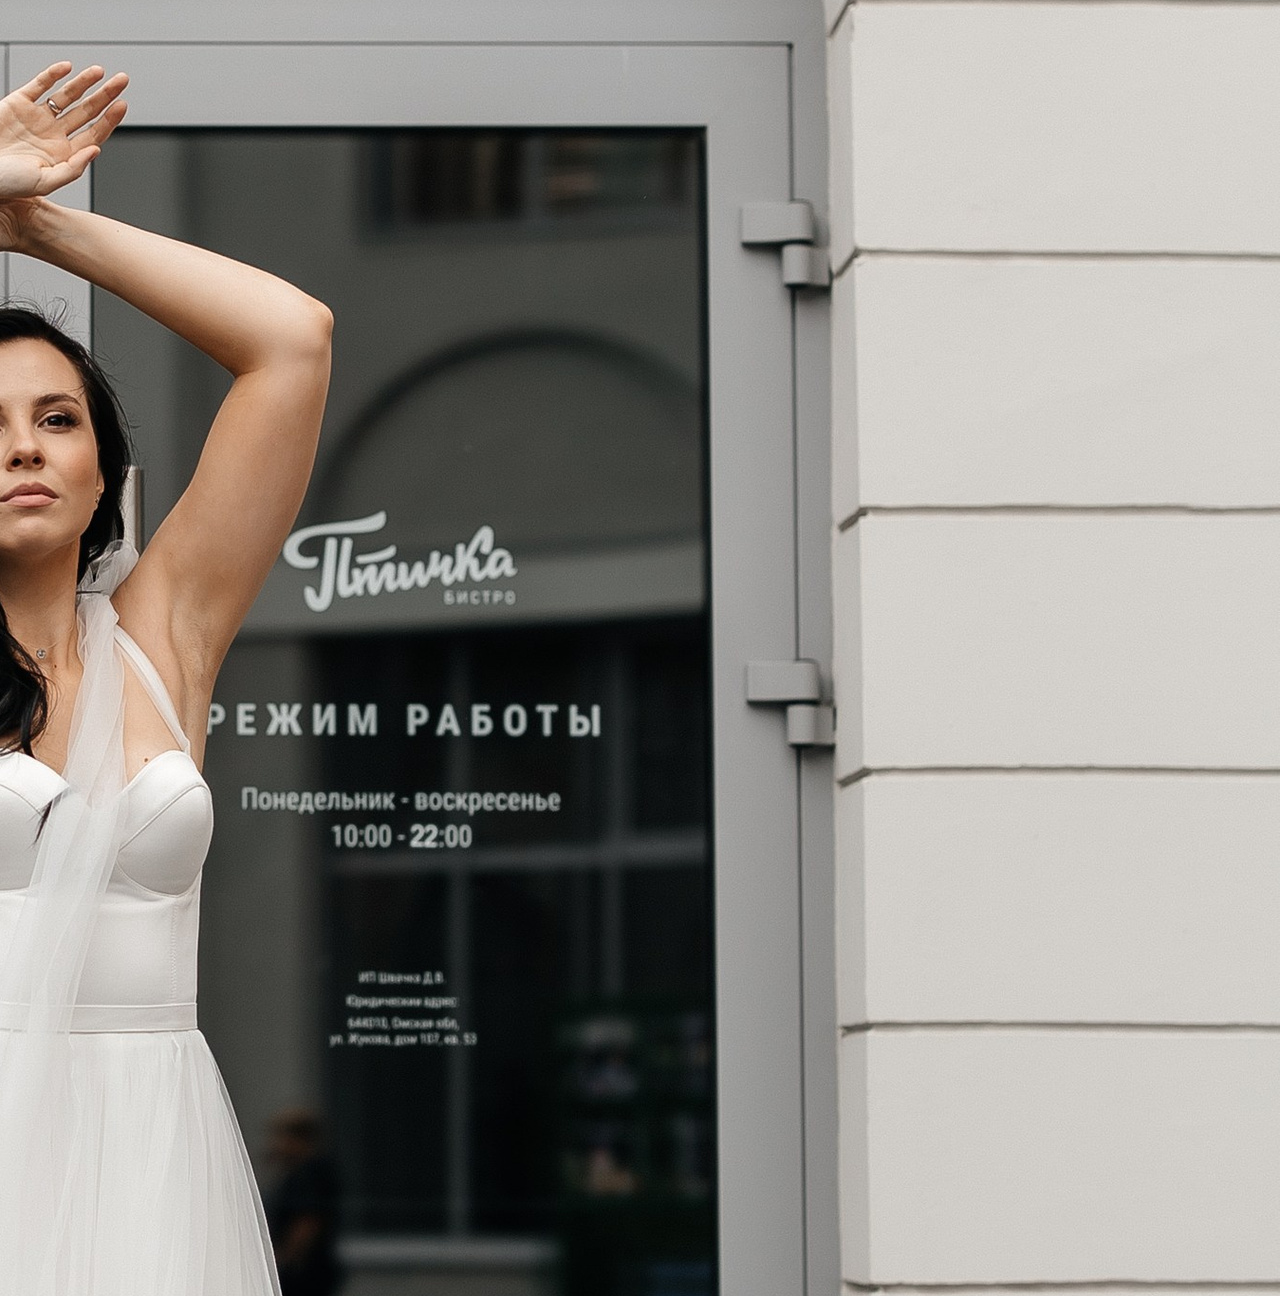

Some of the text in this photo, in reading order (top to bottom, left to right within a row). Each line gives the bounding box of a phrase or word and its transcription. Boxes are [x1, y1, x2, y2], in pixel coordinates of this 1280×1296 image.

[282, 510, 518, 612] Птичка
[443, 589, 516, 605] БИСТРО
[207, 703, 601, 737] РЕЖИМ РАБОТЫ
[241, 786, 395, 815] Понедельник
[414, 792, 562, 816] воскресенье
[331, 823, 392, 848] 10:00
[409, 823, 473, 848] 22:00
